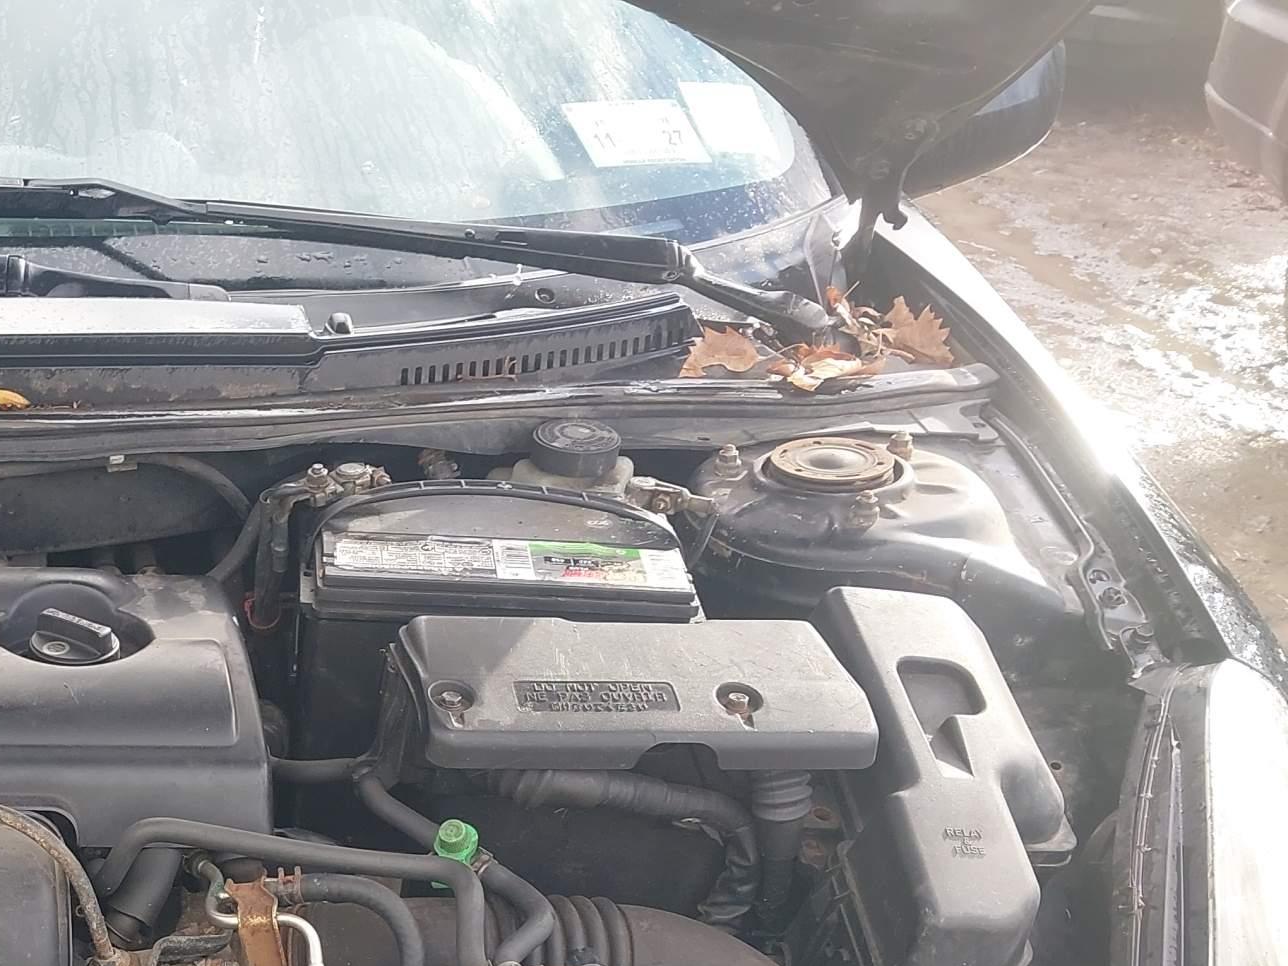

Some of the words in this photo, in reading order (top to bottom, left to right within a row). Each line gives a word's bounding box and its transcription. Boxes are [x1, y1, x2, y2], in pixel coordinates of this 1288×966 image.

[533, 682, 556, 692] DO
[565, 682, 599, 693] NOT
[608, 682, 652, 693] OPEN
[525, 692, 548, 702] NE
[556, 692, 592, 702] PAS
[953, 844, 986, 856] FUSE
